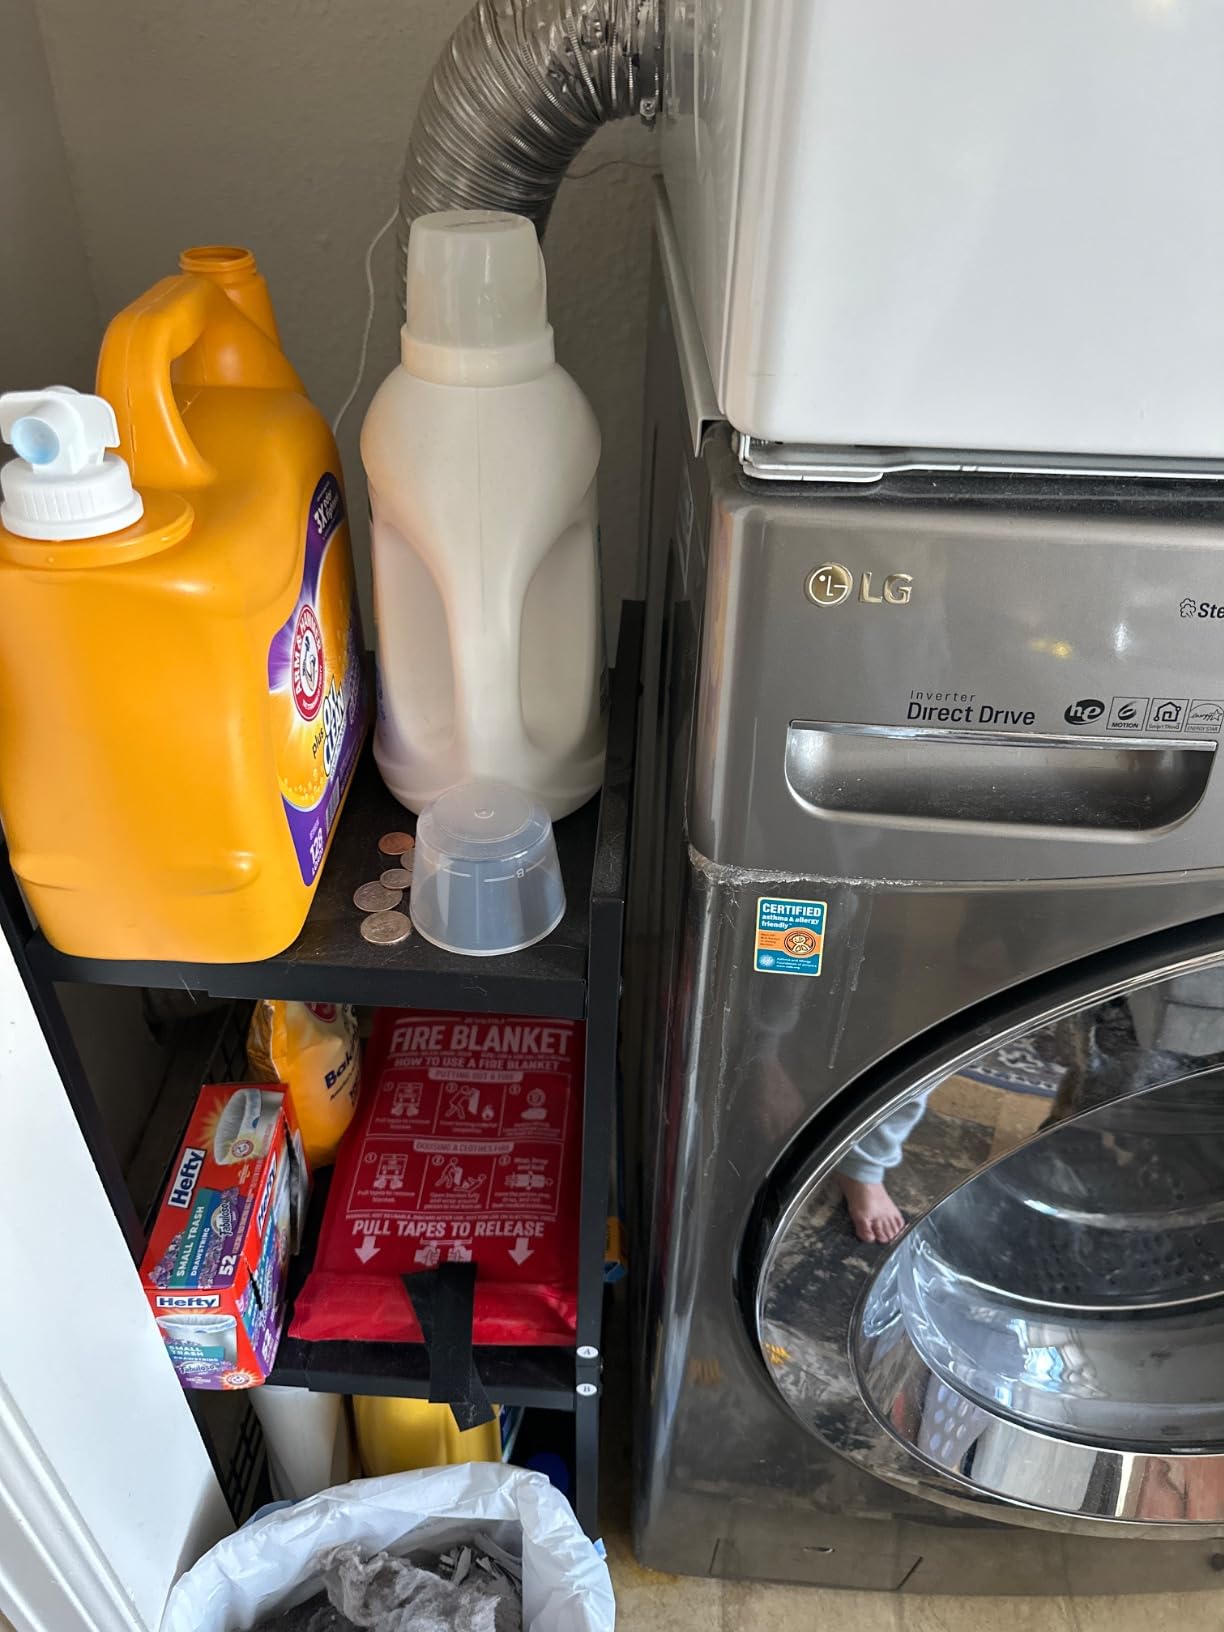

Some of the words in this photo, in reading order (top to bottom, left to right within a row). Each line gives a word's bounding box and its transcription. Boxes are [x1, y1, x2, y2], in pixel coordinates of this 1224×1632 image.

[859, 572, 913, 604] LG
[293, 654, 303, 696] ARM
[910, 690, 976, 702] Inverter
[907, 702, 974, 722] Direct
[978, 705, 1036, 725] Drive
[312, 727, 324, 760] plus
[762, 902, 822, 917] CERTIFIED
[762, 914, 789, 922] asthma
[795, 917, 820, 925] allergy
[389, 1025, 446, 1053] FIRE
[449, 1025, 574, 1056] BLANKET
[394, 1056, 424, 1067] HOW
[425, 1056, 441, 1067] TO
[442, 1057, 466, 1068] USE
[466, 1058, 477, 1068] A
[479, 1059, 505, 1070] FIRE
[506, 1060, 560, 1071] BLANKET
[171, 1150, 204, 1205] Hefty
[219, 1199, 233, 1237] Fabuloso
[352, 1219, 392, 1236] PULL
[396, 1220, 447, 1237] TAPES
[450, 1221, 471, 1237] TO
[474, 1221, 545, 1237] RELEASE
[176, 1242, 194, 1277] SMALL
[187, 1206, 205, 1240] TRASH
[190, 1227, 211, 1277] DRAWSTRING
[218, 1254, 237, 1276] 52
[159, 1297, 217, 1308] Hefty
